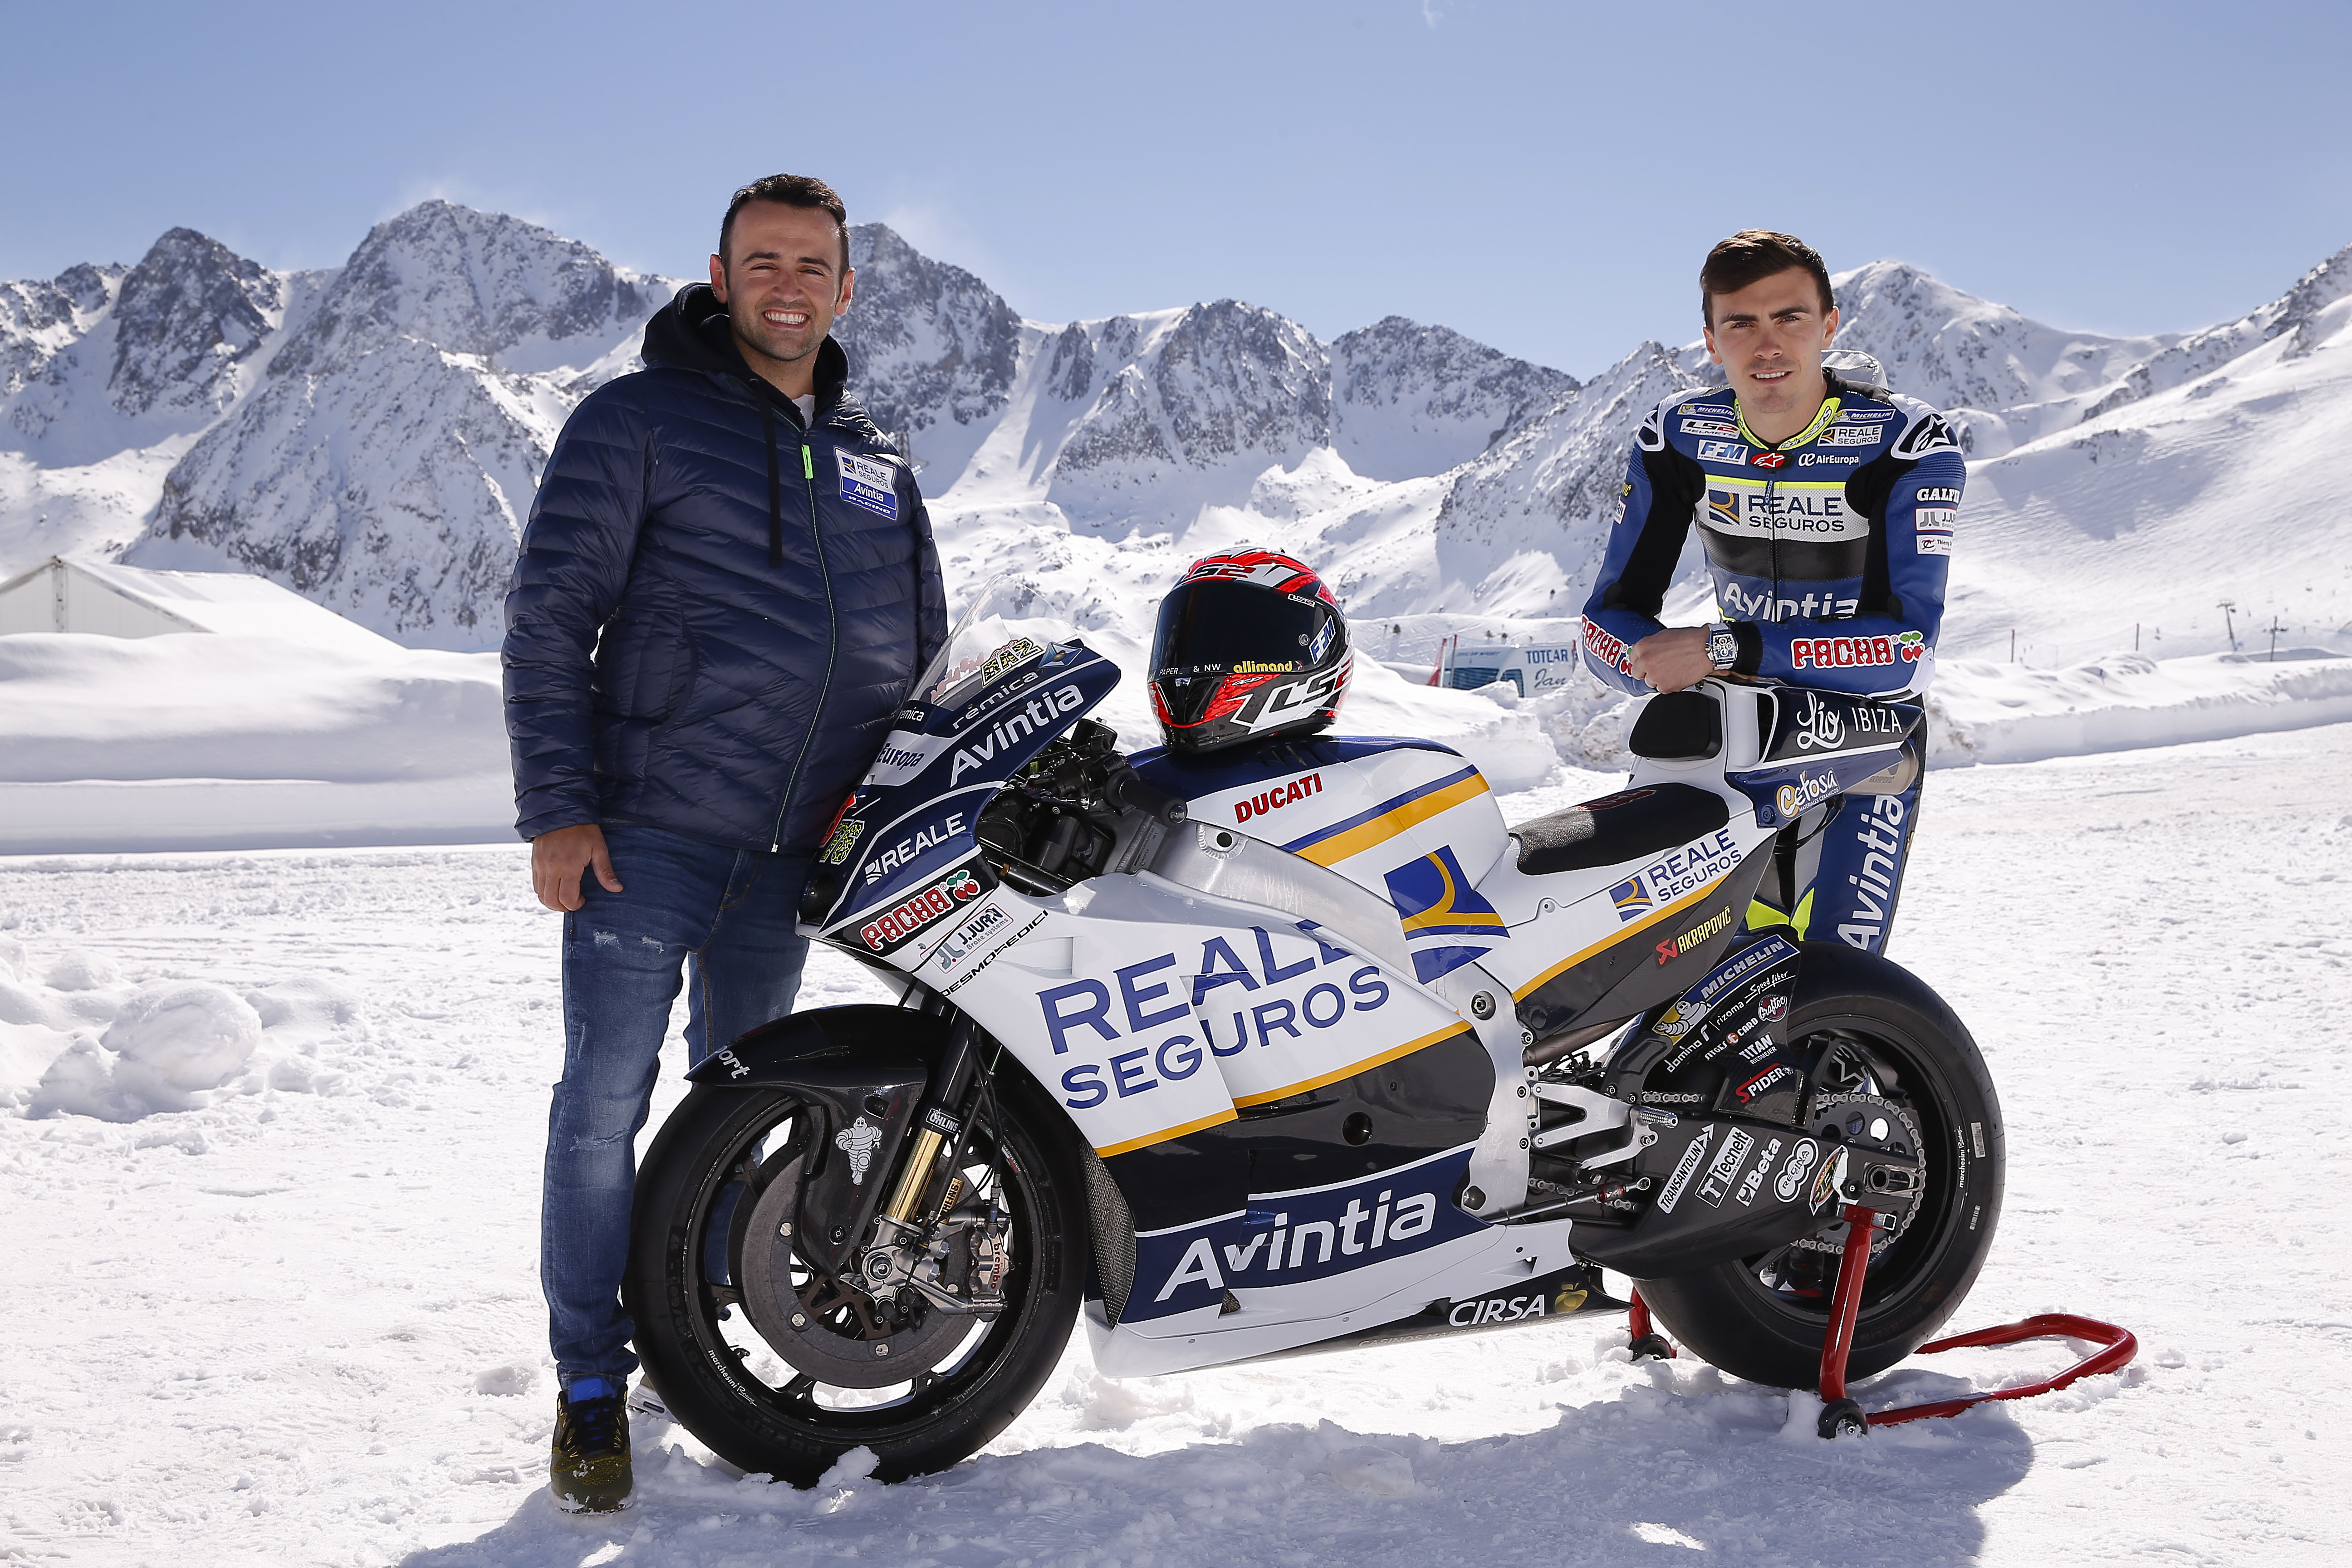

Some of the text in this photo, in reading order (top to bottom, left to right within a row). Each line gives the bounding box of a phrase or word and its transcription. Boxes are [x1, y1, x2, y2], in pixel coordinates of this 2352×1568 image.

[1686, 421, 1739, 433] LS2
[1697, 407, 1735, 416] MICHELIN
[1682, 428, 1736, 437] HELMETS
[1838, 427, 1880, 436] REALE
[856, 461, 887, 481] REALE
[1816, 455, 1859, 465] AirEuropa
[854, 483, 884, 502] Avintia
[858, 471, 888, 488] SEGUROS
[848, 496, 891, 514] RACING
[1749, 495, 1843, 515] REALE
[1749, 516, 1844, 532] SEGUROS
[1288, 593, 1315, 608] LS2
[1724, 582, 1859, 622] Avintia
[980, 637, 1044, 688] BAZ
[1233, 661, 1292, 673] allimand
[1525, 649, 1568, 663] TOTCAR
[1792, 636, 1895, 669] PACHA
[1159, 667, 1179, 676] PAPER
[951, 685, 1084, 788] Avintia
[1852, 707, 1903, 734] IBIZA
[1234, 773, 1323, 824] DUCATI
[1798, 797, 1819, 812] MATERIALES
[881, 812, 967, 875] REALE
[1647, 828, 1736, 888] REALE
[1658, 850, 1743, 902] SEGUROS
[1838, 795, 1905, 951] Avintia
[860, 886, 954, 951] PACHA
[966, 918, 1009, 950] Brake systems
[1701, 941, 1785, 999] MICHELIN
[1748, 971, 1788, 996] Speed fiber
[1717, 1001, 1744, 1025] rizoma
[1737, 1018, 1759, 1036] CARD
[1061, 965, 1389, 1109] SEGUROS
[1739, 1034, 1774, 1059] TITAN
[715, 1046, 750, 1079] ort
[1664, 1040, 1702, 1073] domino
[1749, 1046, 1777, 1065] RIEDMEIER
[1735, 1065, 1785, 1103] SPIDER
[1712, 1132, 1749, 1178] Tecnelt
[1744, 1138, 1782, 1191] Beta
[1780, 1149, 1809, 1189] REGINA
[1661, 1144, 1701, 1209] TRANSANTOLIN
[942, 1182, 959, 1213] HLINS
[1154, 1190, 1437, 1302] Avintia
[991, 1242, 1001, 1289] brembo
[1449, 1294, 1545, 1327] CIRSA
[708, 1350, 740, 1389] marchesini
